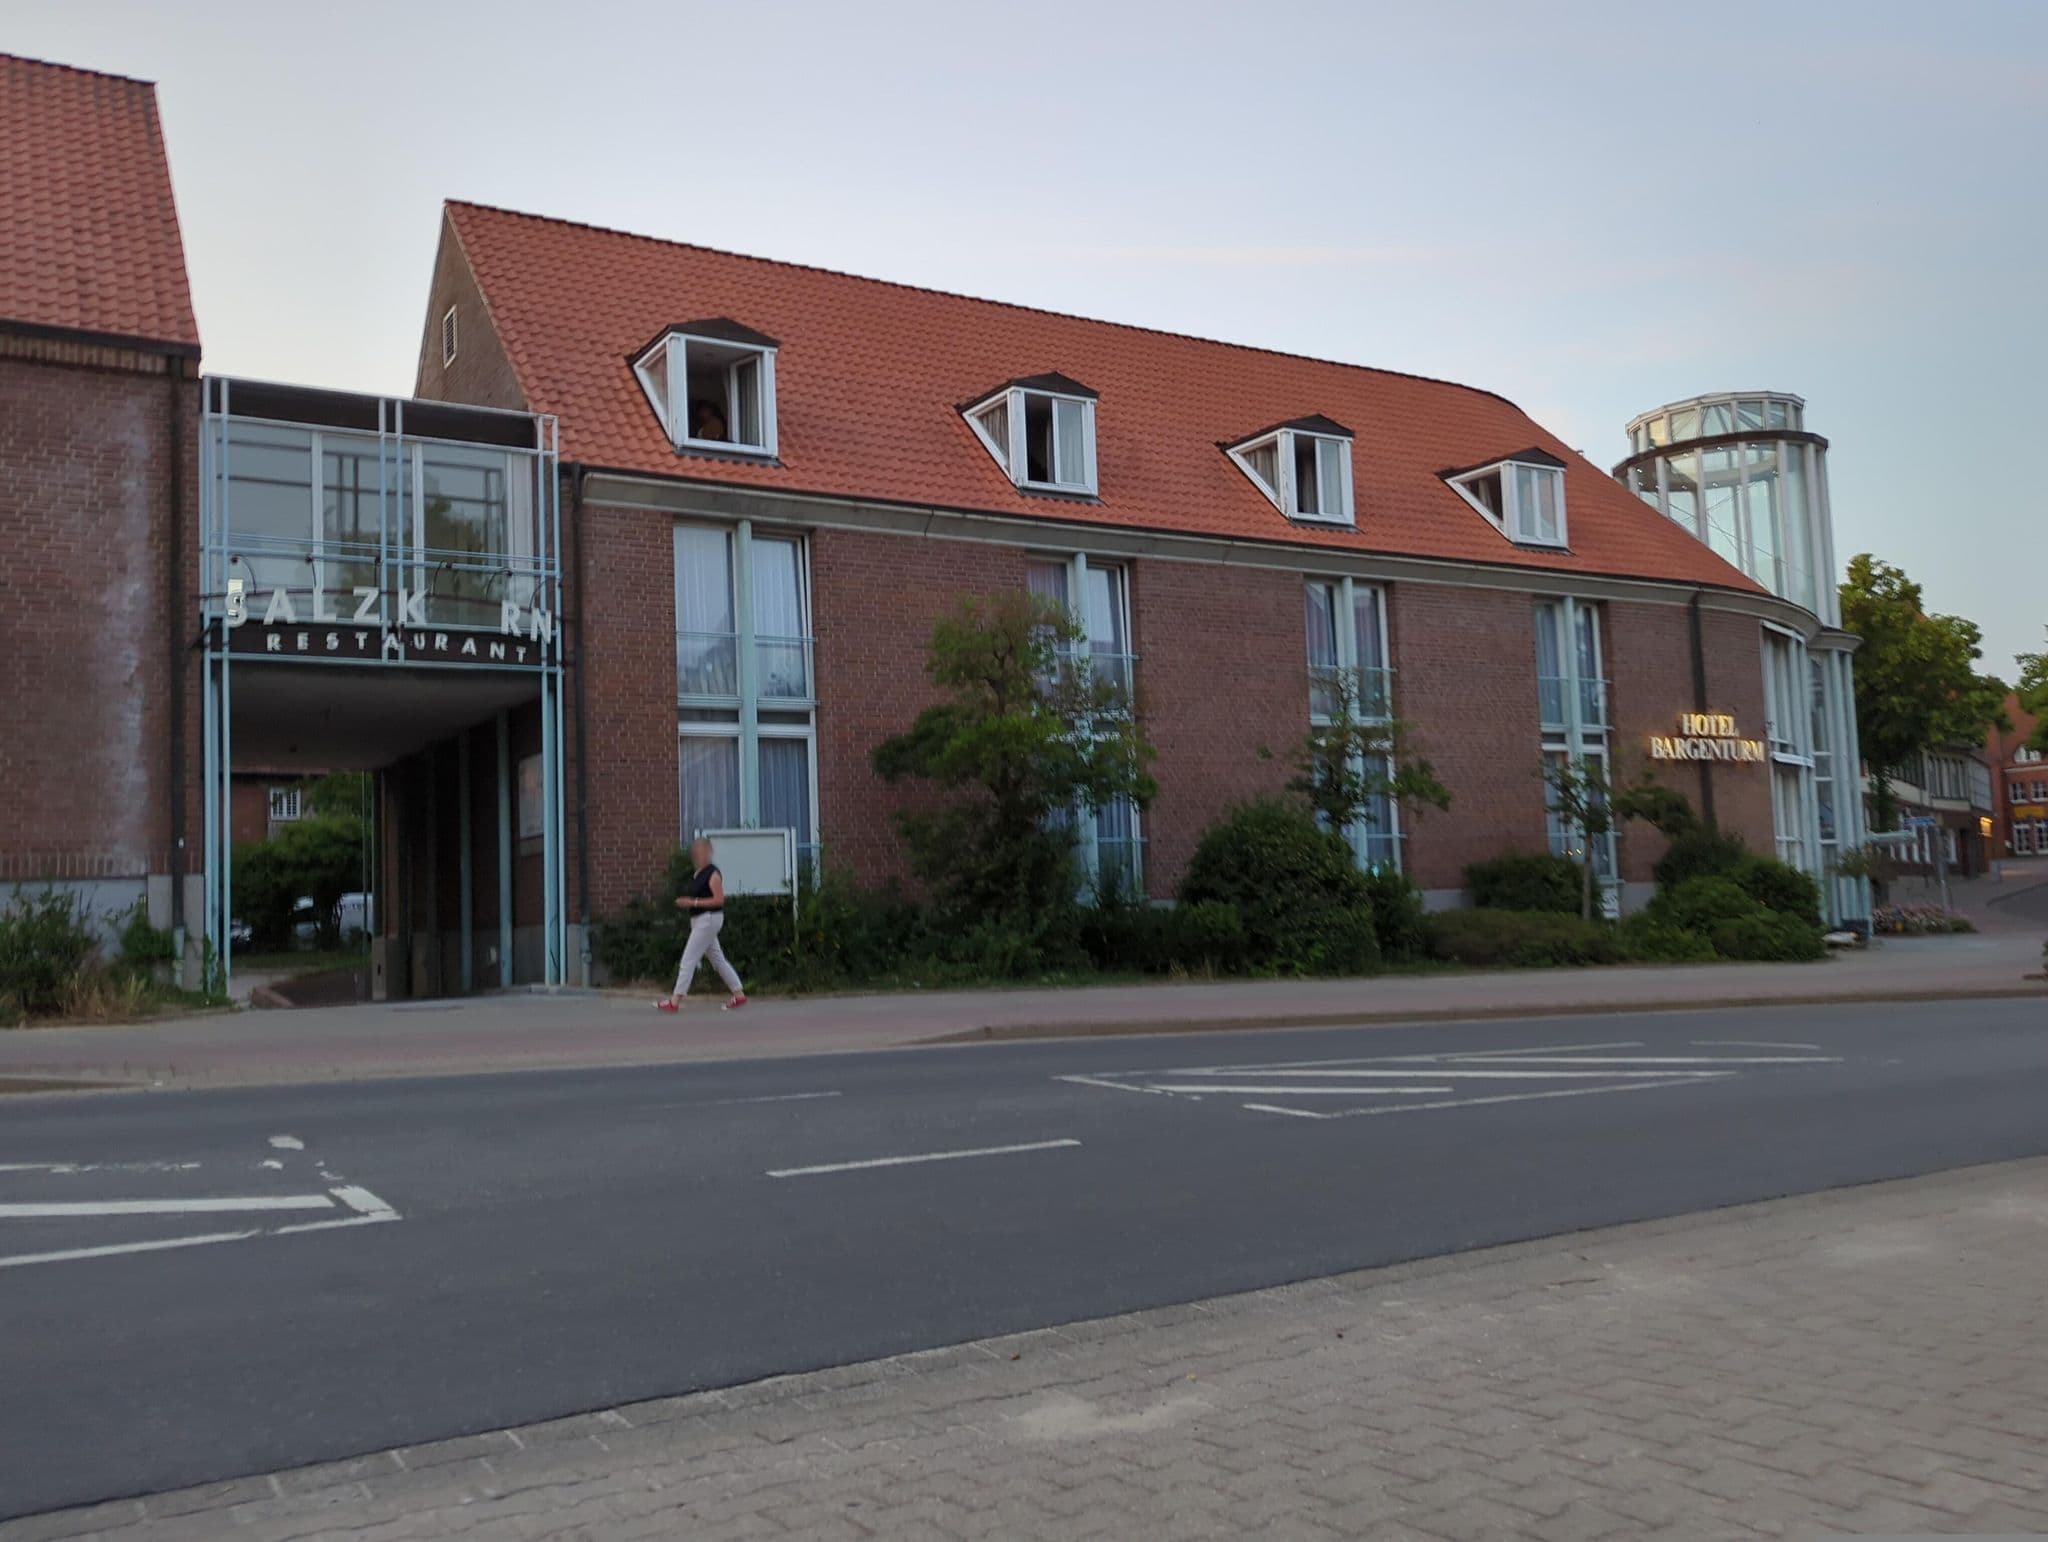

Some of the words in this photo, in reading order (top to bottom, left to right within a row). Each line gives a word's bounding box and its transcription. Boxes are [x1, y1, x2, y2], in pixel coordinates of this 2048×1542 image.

[225, 585, 552, 645] SALZKRN
[267, 632, 527, 664] RESTAURANT
[1682, 713, 1740, 737] HOTEL
[1650, 736, 1766, 762] BARGENTURM
